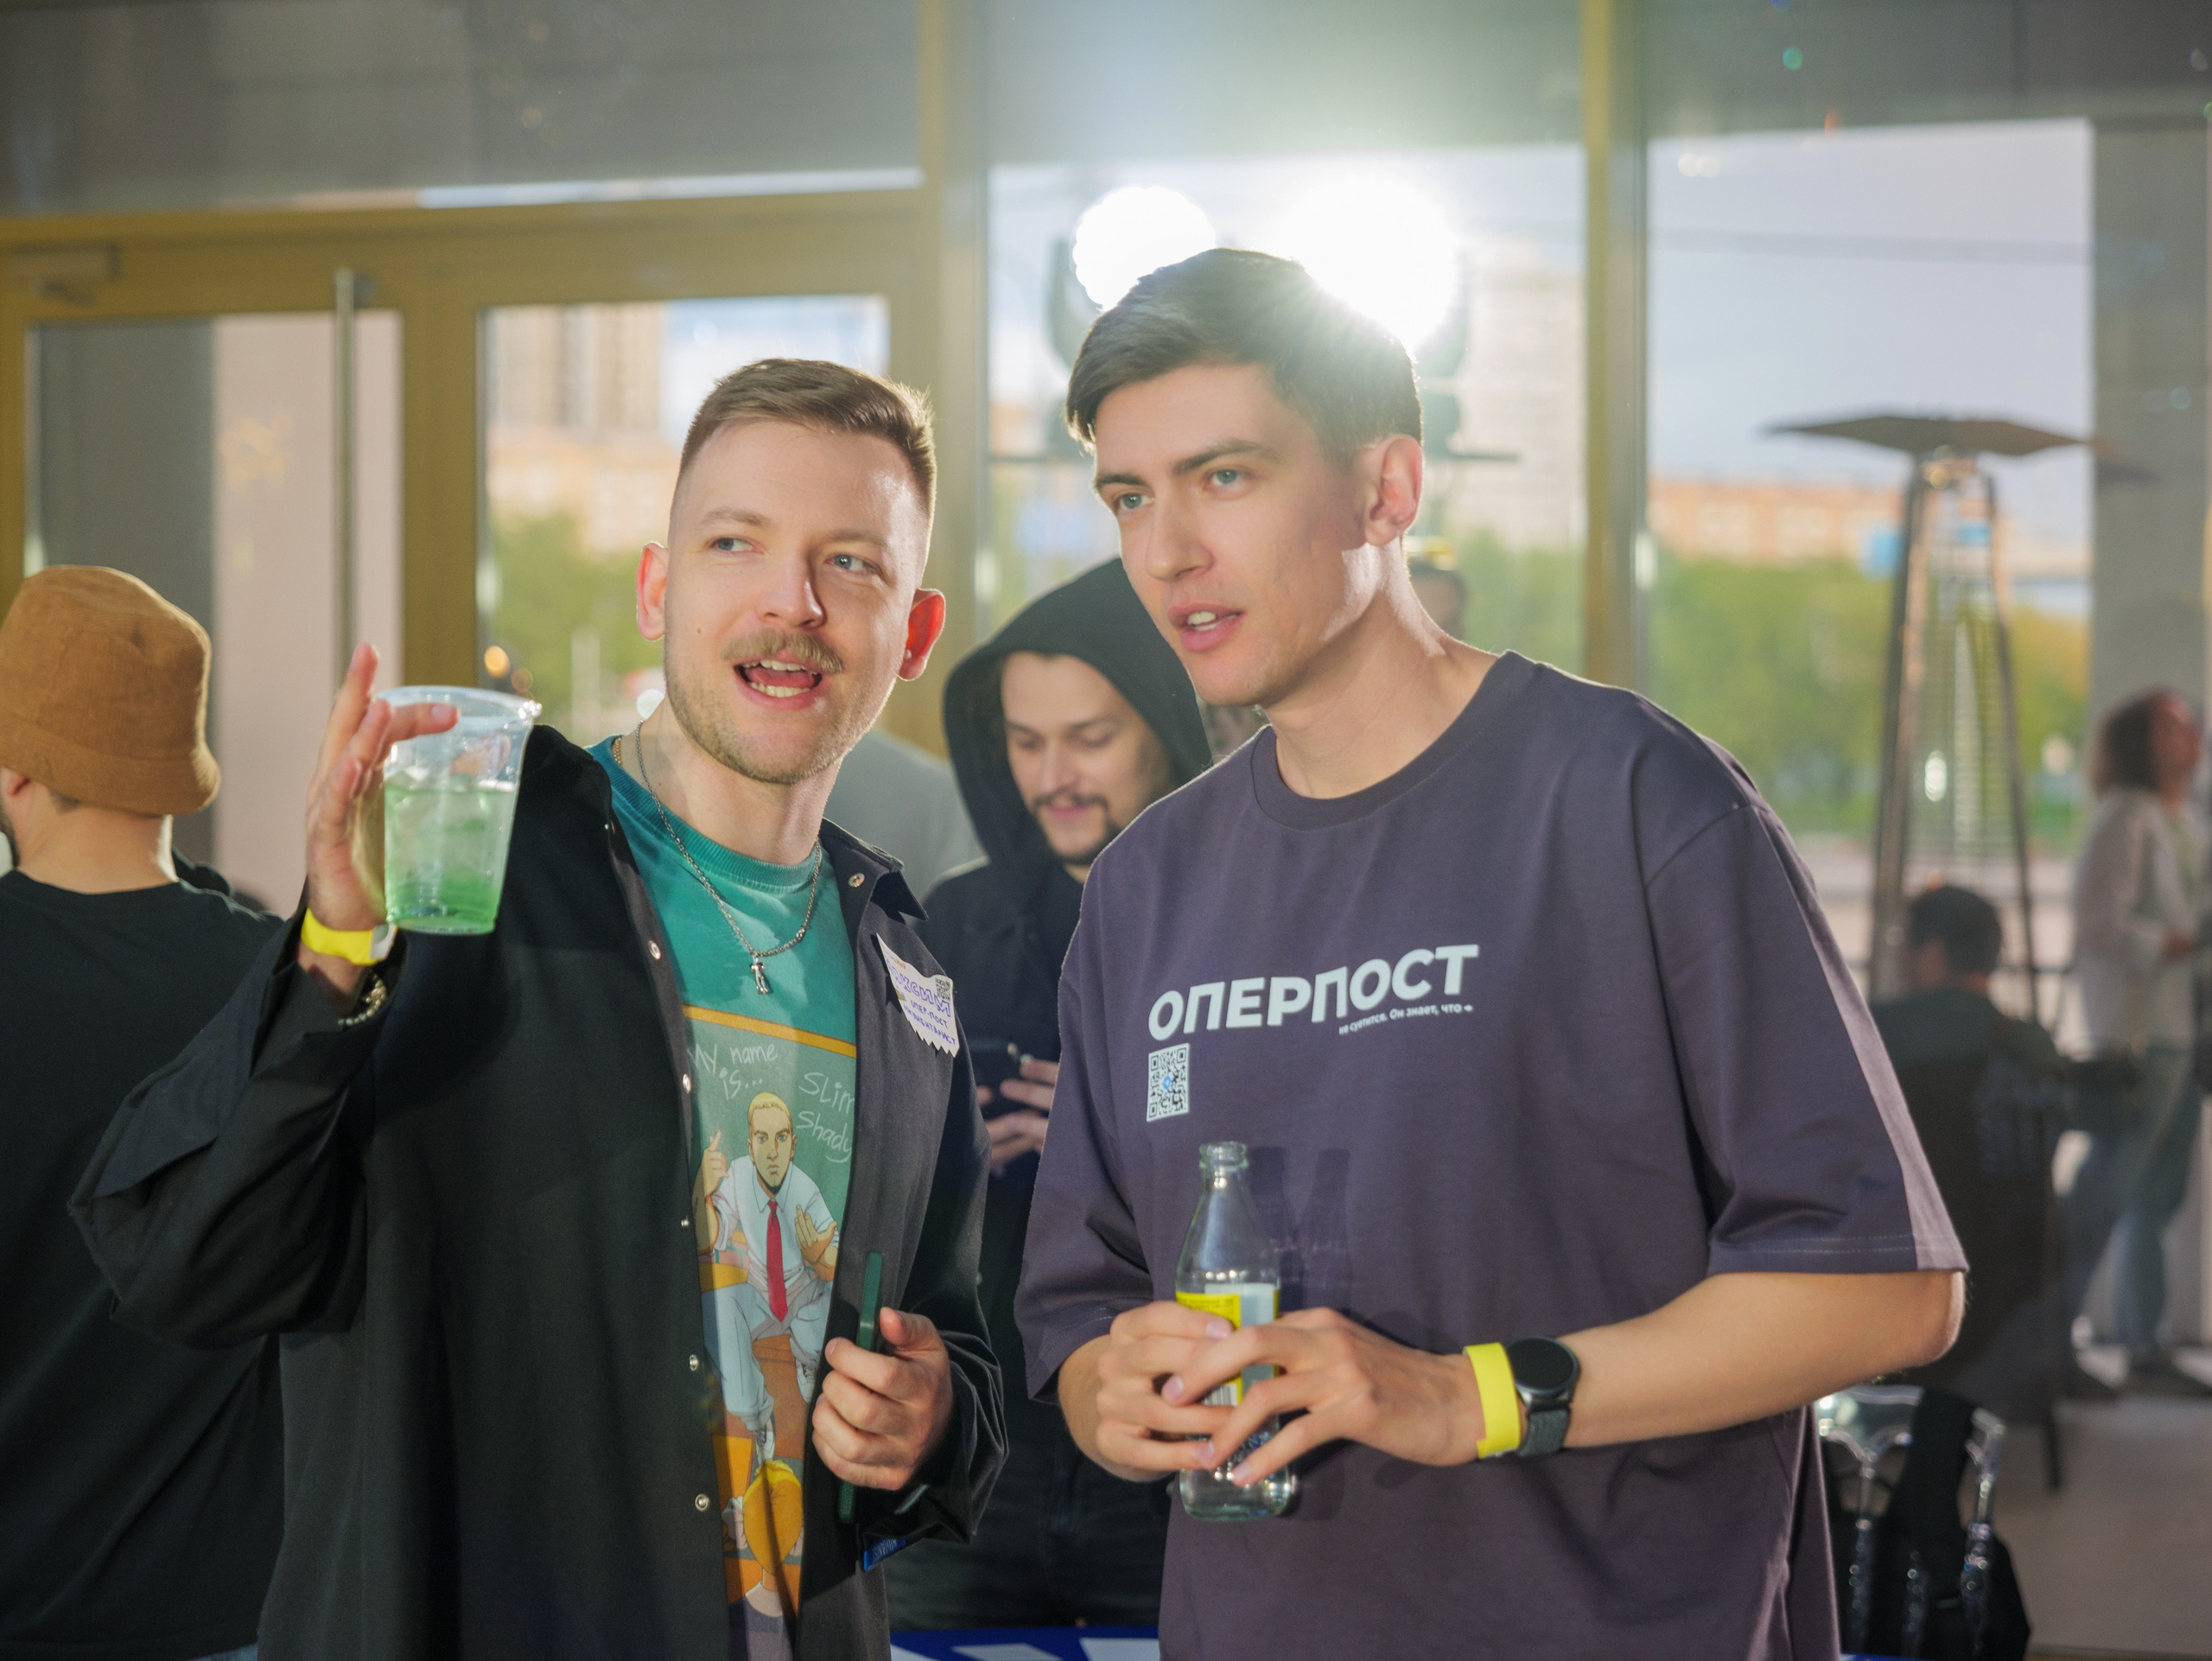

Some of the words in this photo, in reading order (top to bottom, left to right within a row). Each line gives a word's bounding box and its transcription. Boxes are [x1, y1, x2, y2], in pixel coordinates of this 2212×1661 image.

[1147, 944, 1479, 1041] ОПЕРПОСТ
[1389, 1009, 1405, 1020] Он
[1440, 1003, 1464, 1014] что
[729, 1042, 779, 1066] name
